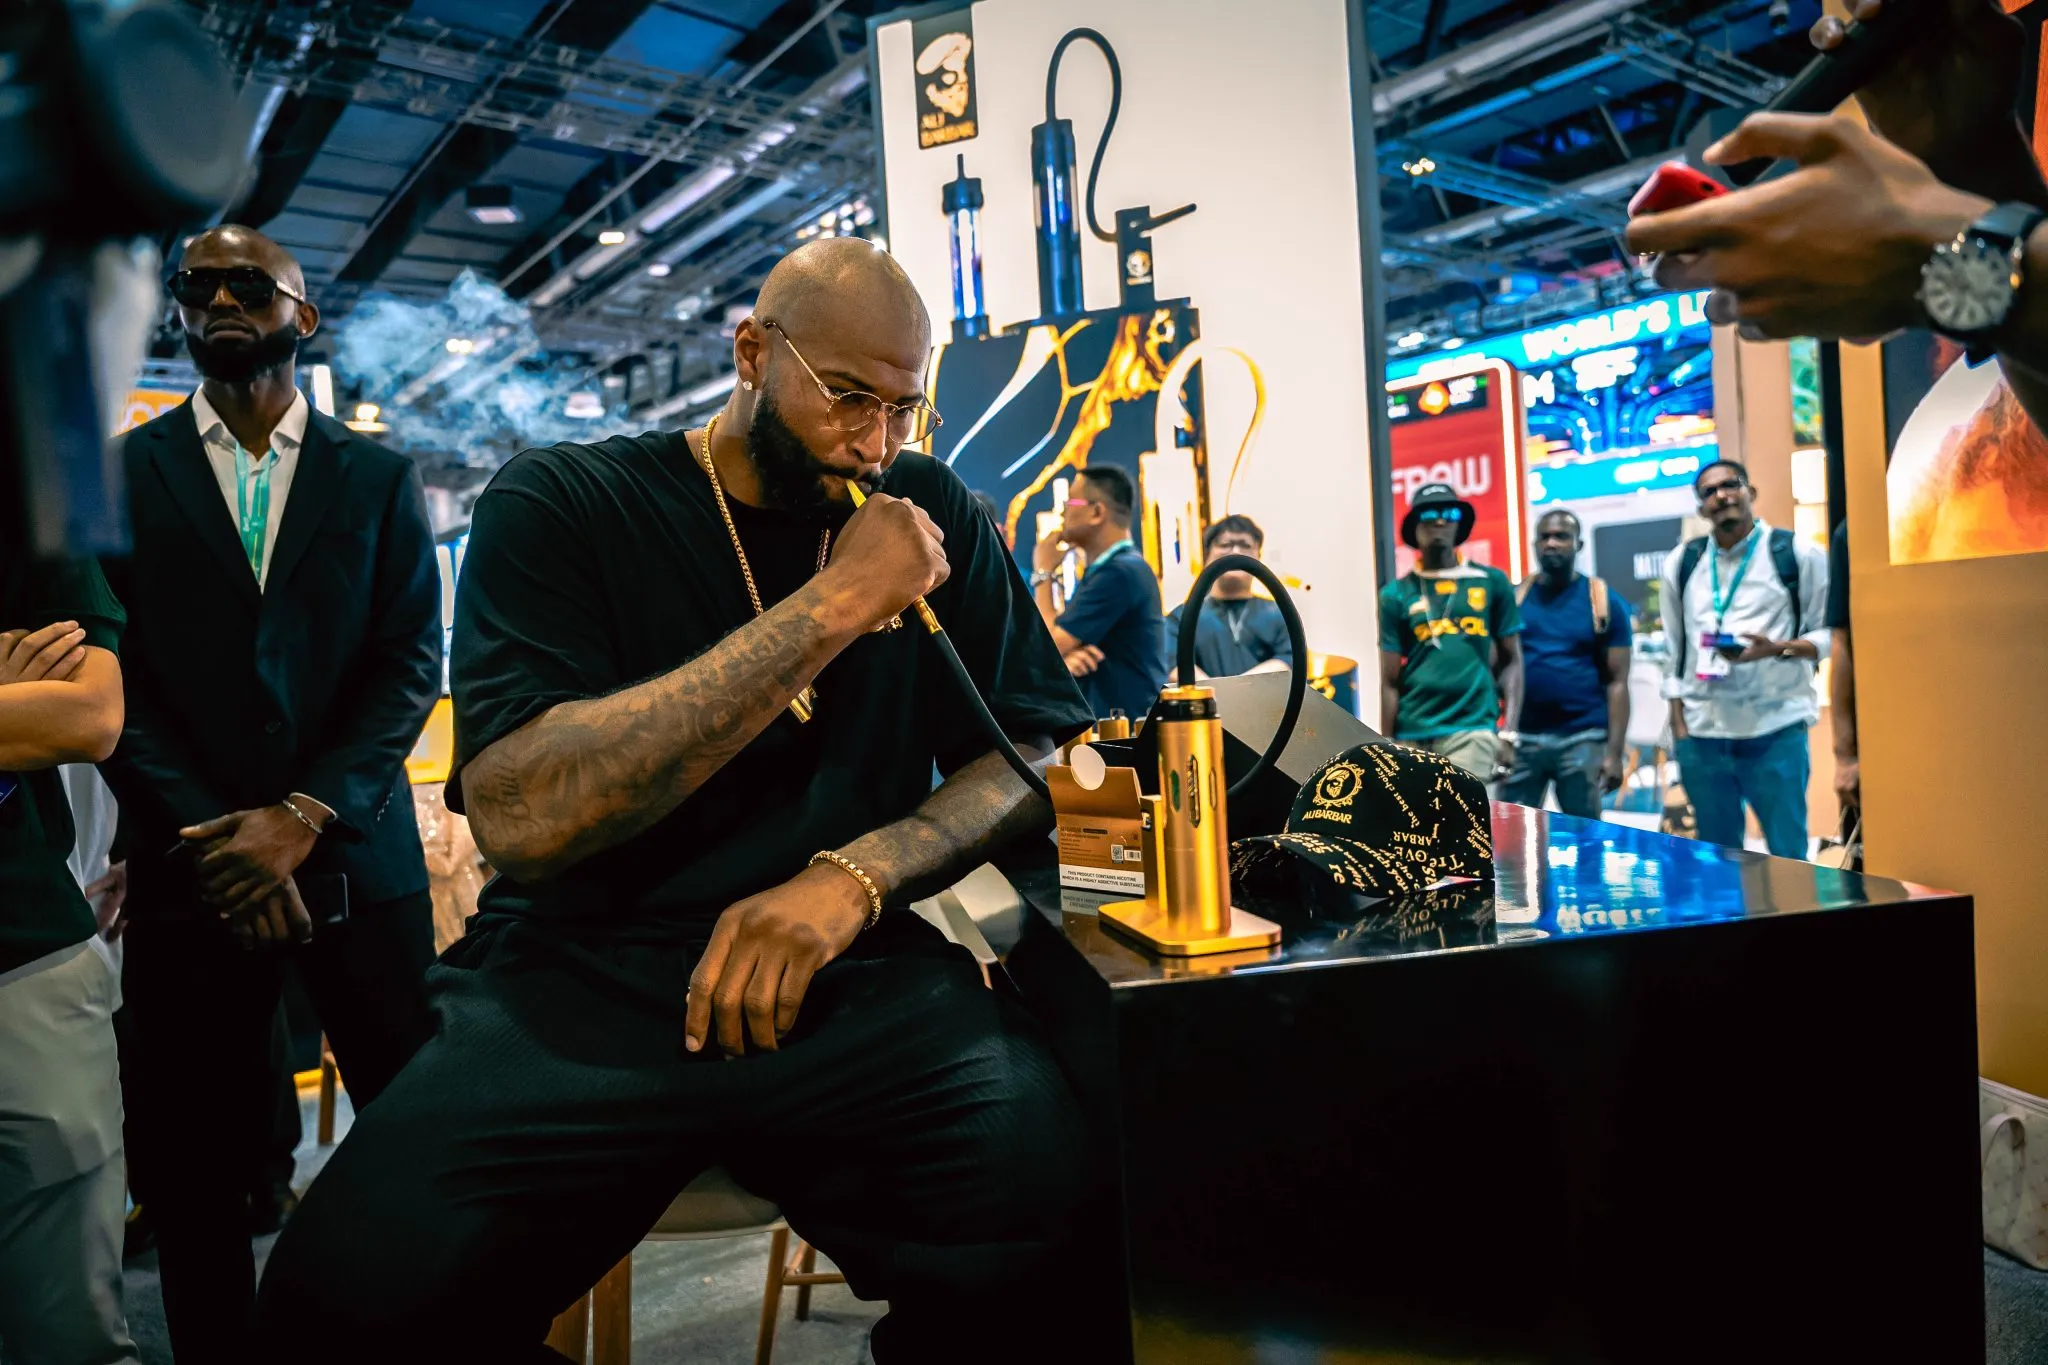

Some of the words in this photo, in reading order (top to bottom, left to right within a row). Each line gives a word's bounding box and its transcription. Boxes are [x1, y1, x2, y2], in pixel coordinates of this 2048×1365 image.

[1522, 301, 1671, 362] WORLD'S
[1393, 792, 1410, 812] best
[1455, 792, 1470, 812] best
[1467, 812, 1490, 839] choice
